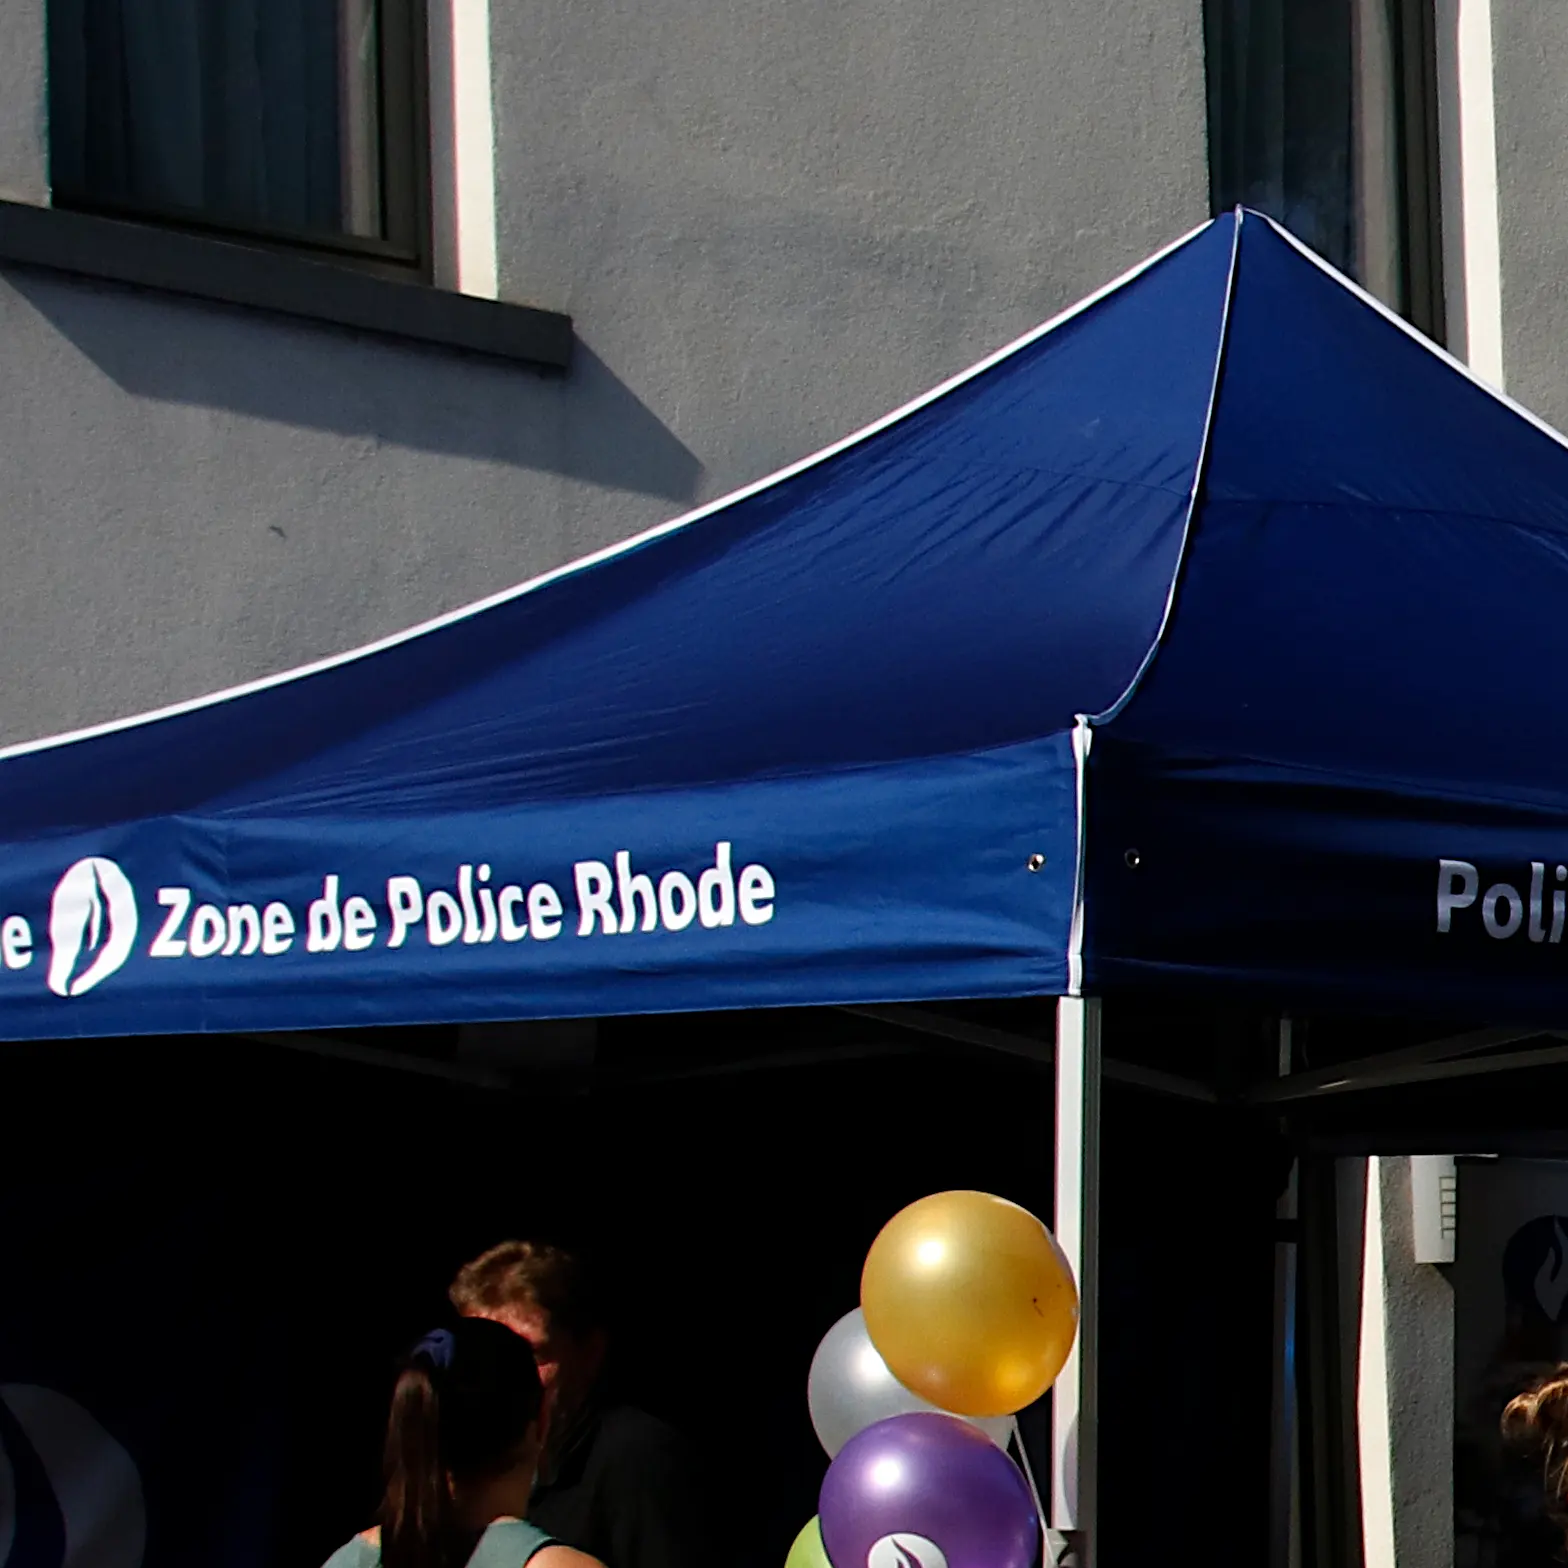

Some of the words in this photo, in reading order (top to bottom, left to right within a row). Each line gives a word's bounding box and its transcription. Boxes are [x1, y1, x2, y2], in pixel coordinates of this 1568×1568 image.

[150, 887, 296, 958] Zone
[306, 873, 378, 953] de
[386, 862, 564, 949] Police
[573, 840, 776, 937] Rhode
